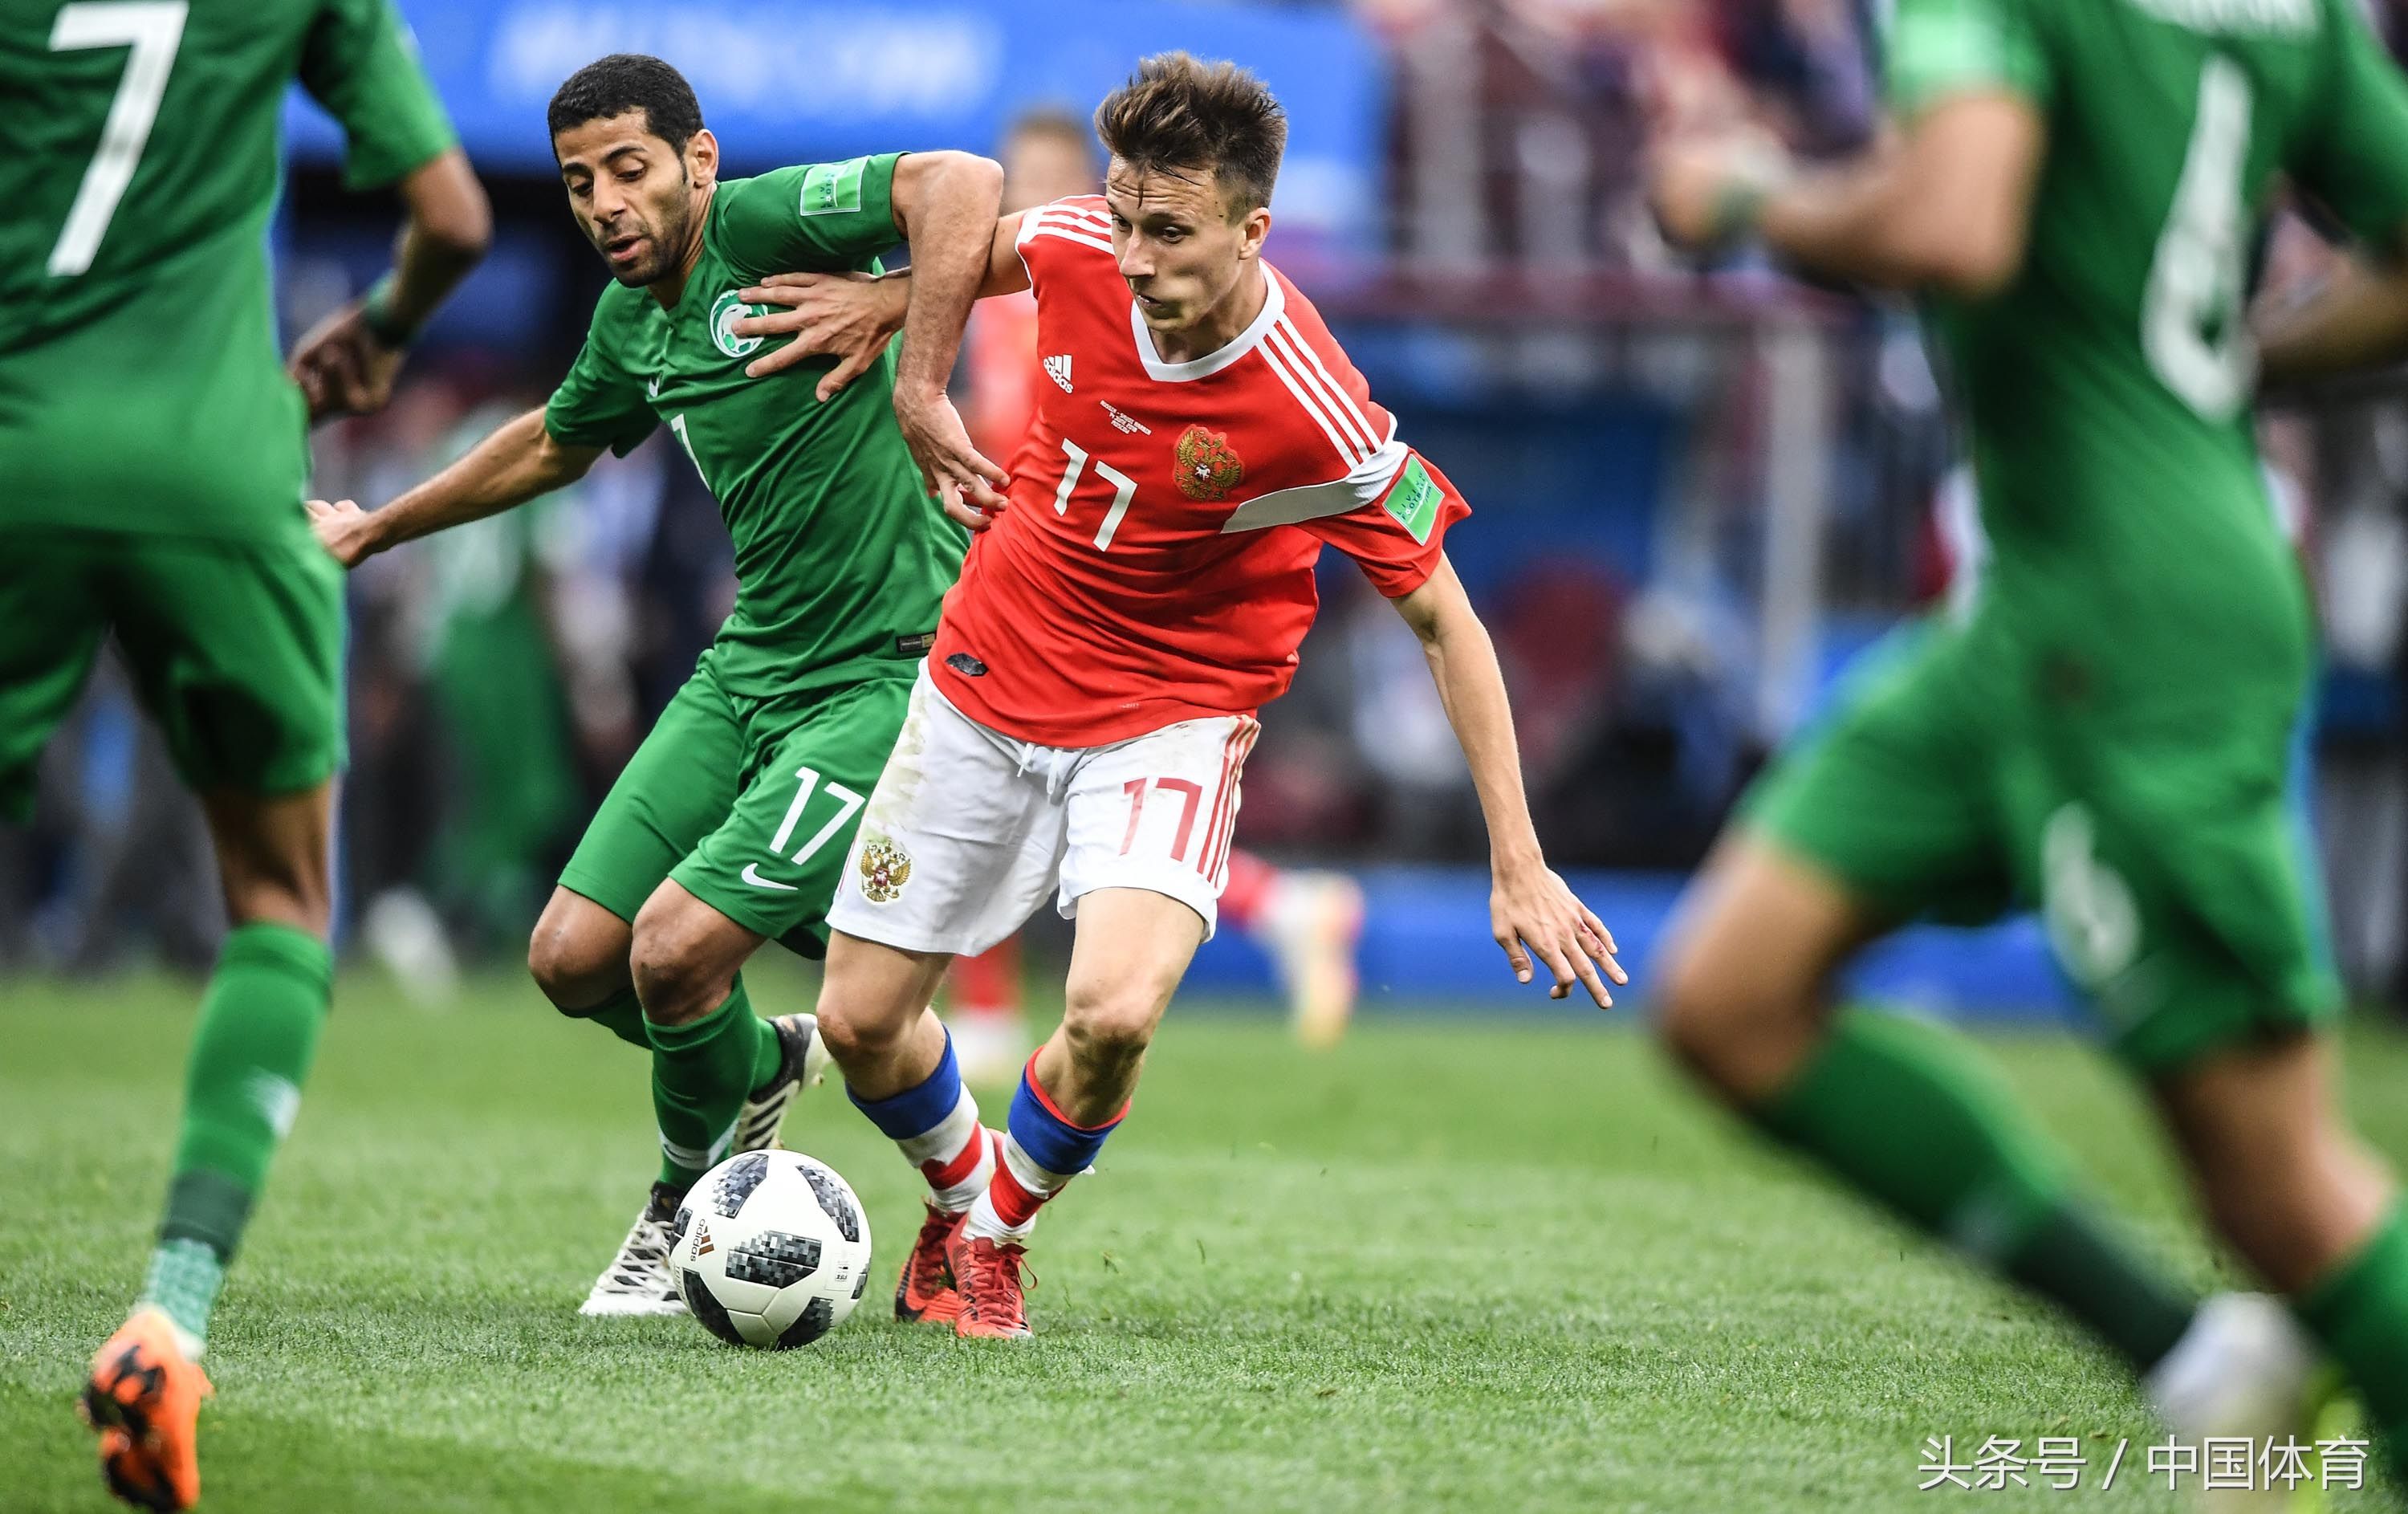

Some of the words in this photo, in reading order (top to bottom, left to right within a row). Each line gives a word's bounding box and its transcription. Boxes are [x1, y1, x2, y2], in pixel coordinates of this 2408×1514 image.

[48, 0, 189, 277] 7
[2140, 53, 2260, 425] 6
[1043, 358, 1074, 393] adidas
[1054, 438, 1138, 552] 17
[769, 767, 866, 865] 17
[1119, 777, 1202, 861] 17
[690, 1219, 705, 1262] adidas
